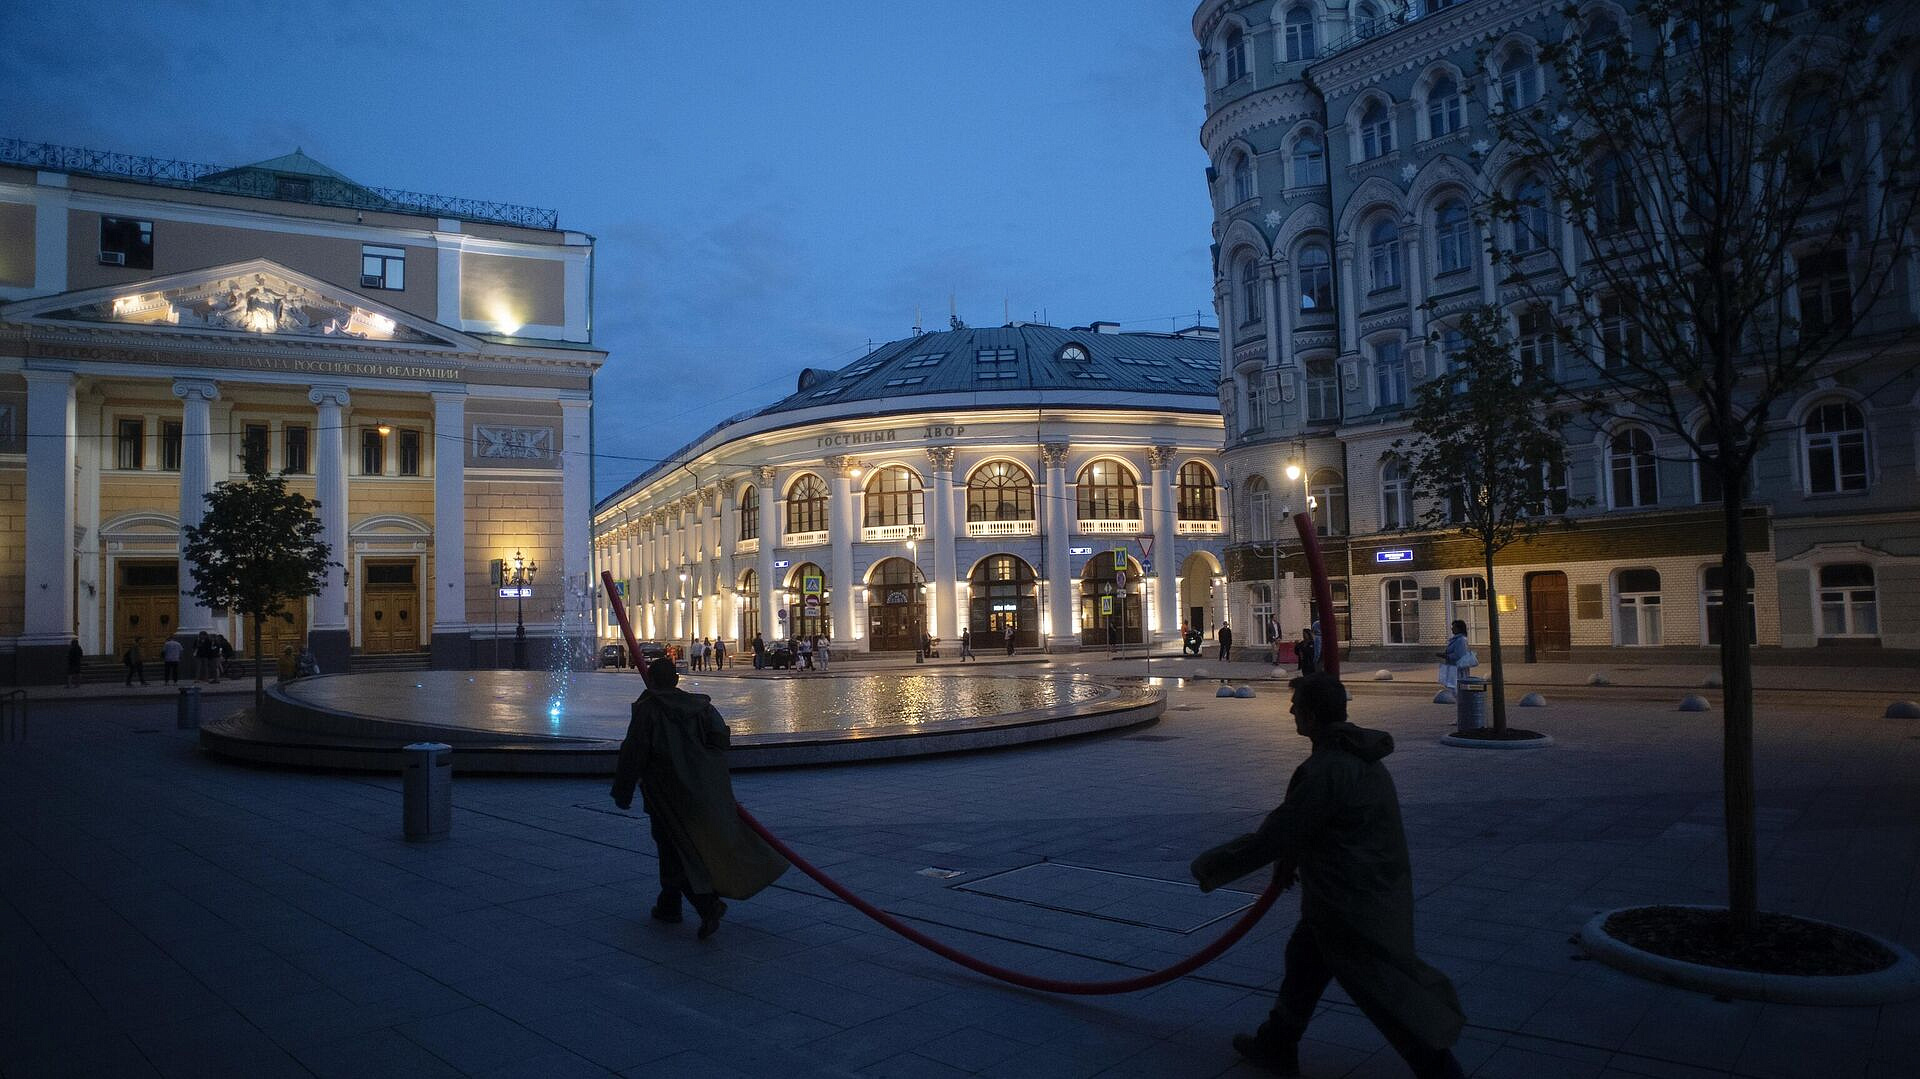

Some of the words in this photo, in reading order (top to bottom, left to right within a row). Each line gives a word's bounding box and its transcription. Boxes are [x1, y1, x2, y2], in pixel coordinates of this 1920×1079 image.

[294, 359, 382, 375] РОССИЙСКОЙ
[386, 364, 459, 380] ФЕДЕРАЦИИ
[817, 430, 896, 448] ГОСТИНЫЙ
[923, 426, 965, 438] ДВОР
